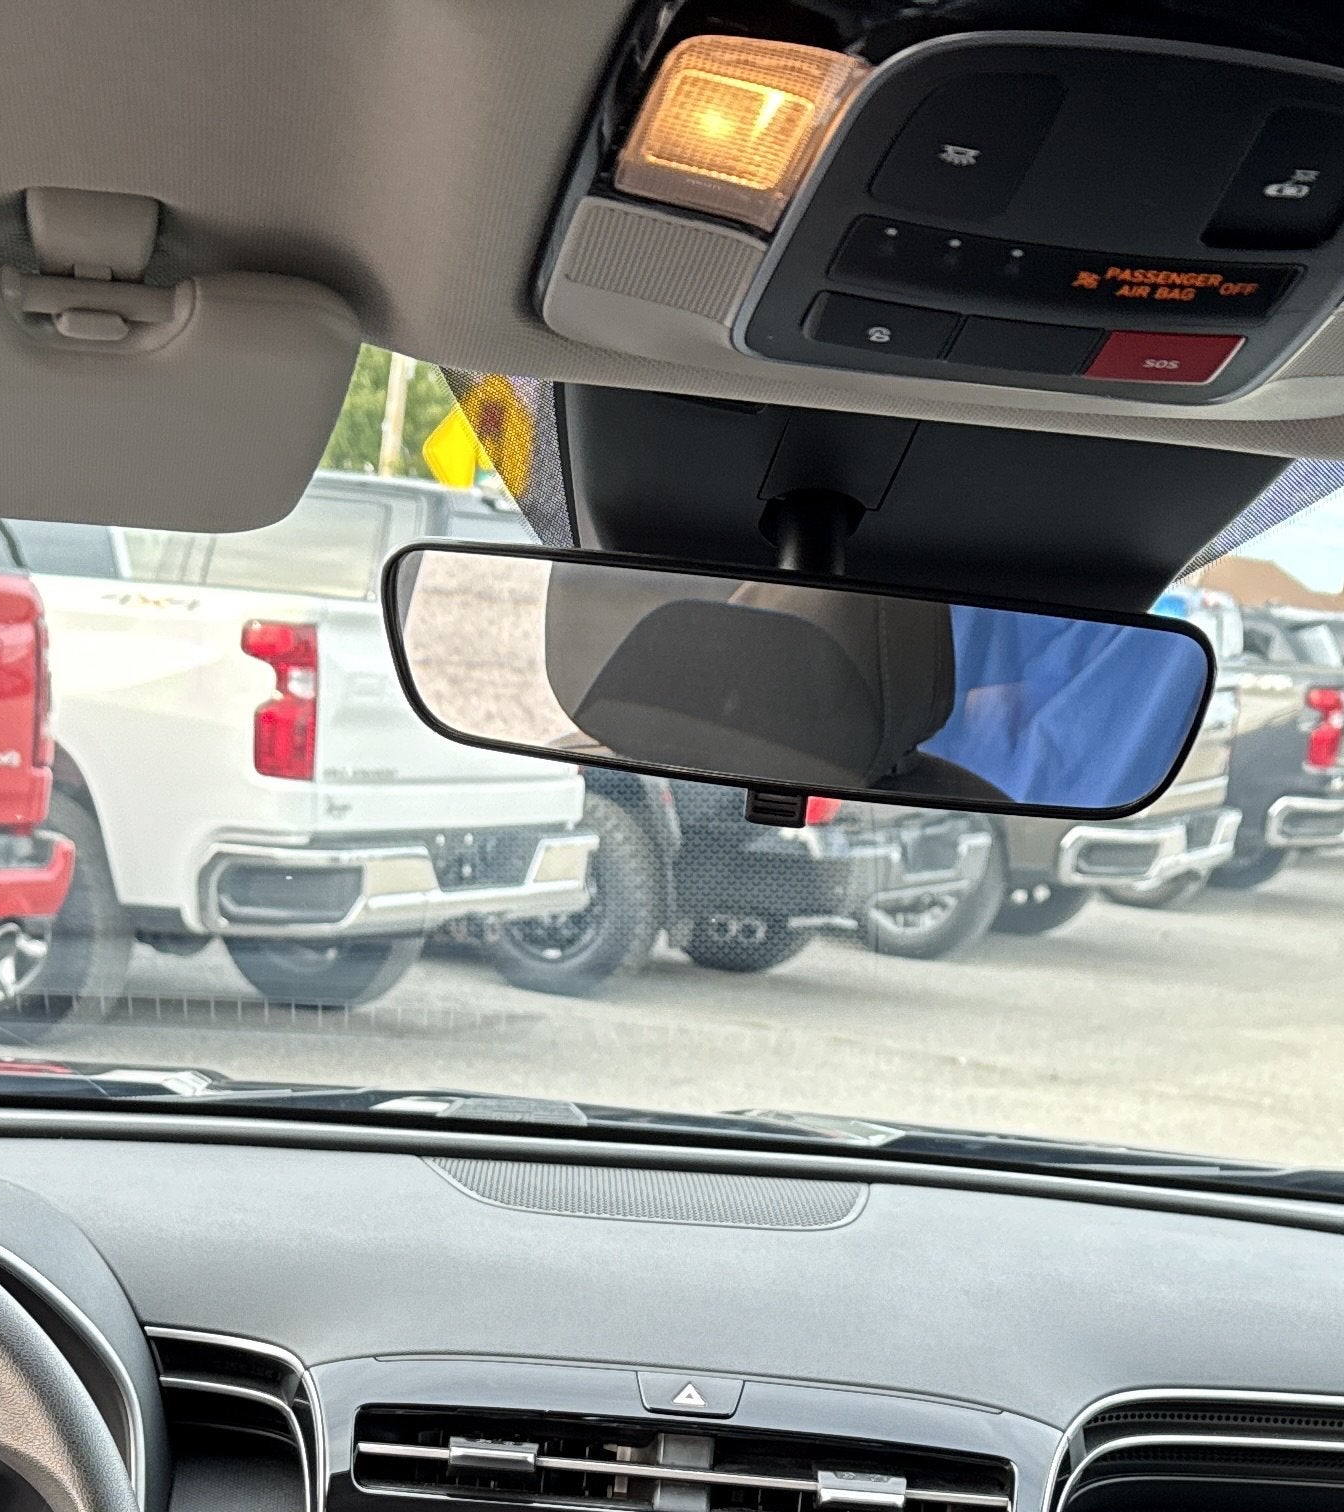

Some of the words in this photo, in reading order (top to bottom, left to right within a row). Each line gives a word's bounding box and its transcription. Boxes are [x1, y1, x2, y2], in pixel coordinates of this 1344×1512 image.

[1106, 267, 1223, 287] PASSENGER
[1116, 285, 1151, 298] AIR
[1154, 287, 1197, 300] BAG
[1219, 283, 1259, 295] OFF
[1143, 358, 1180, 370] SOS
